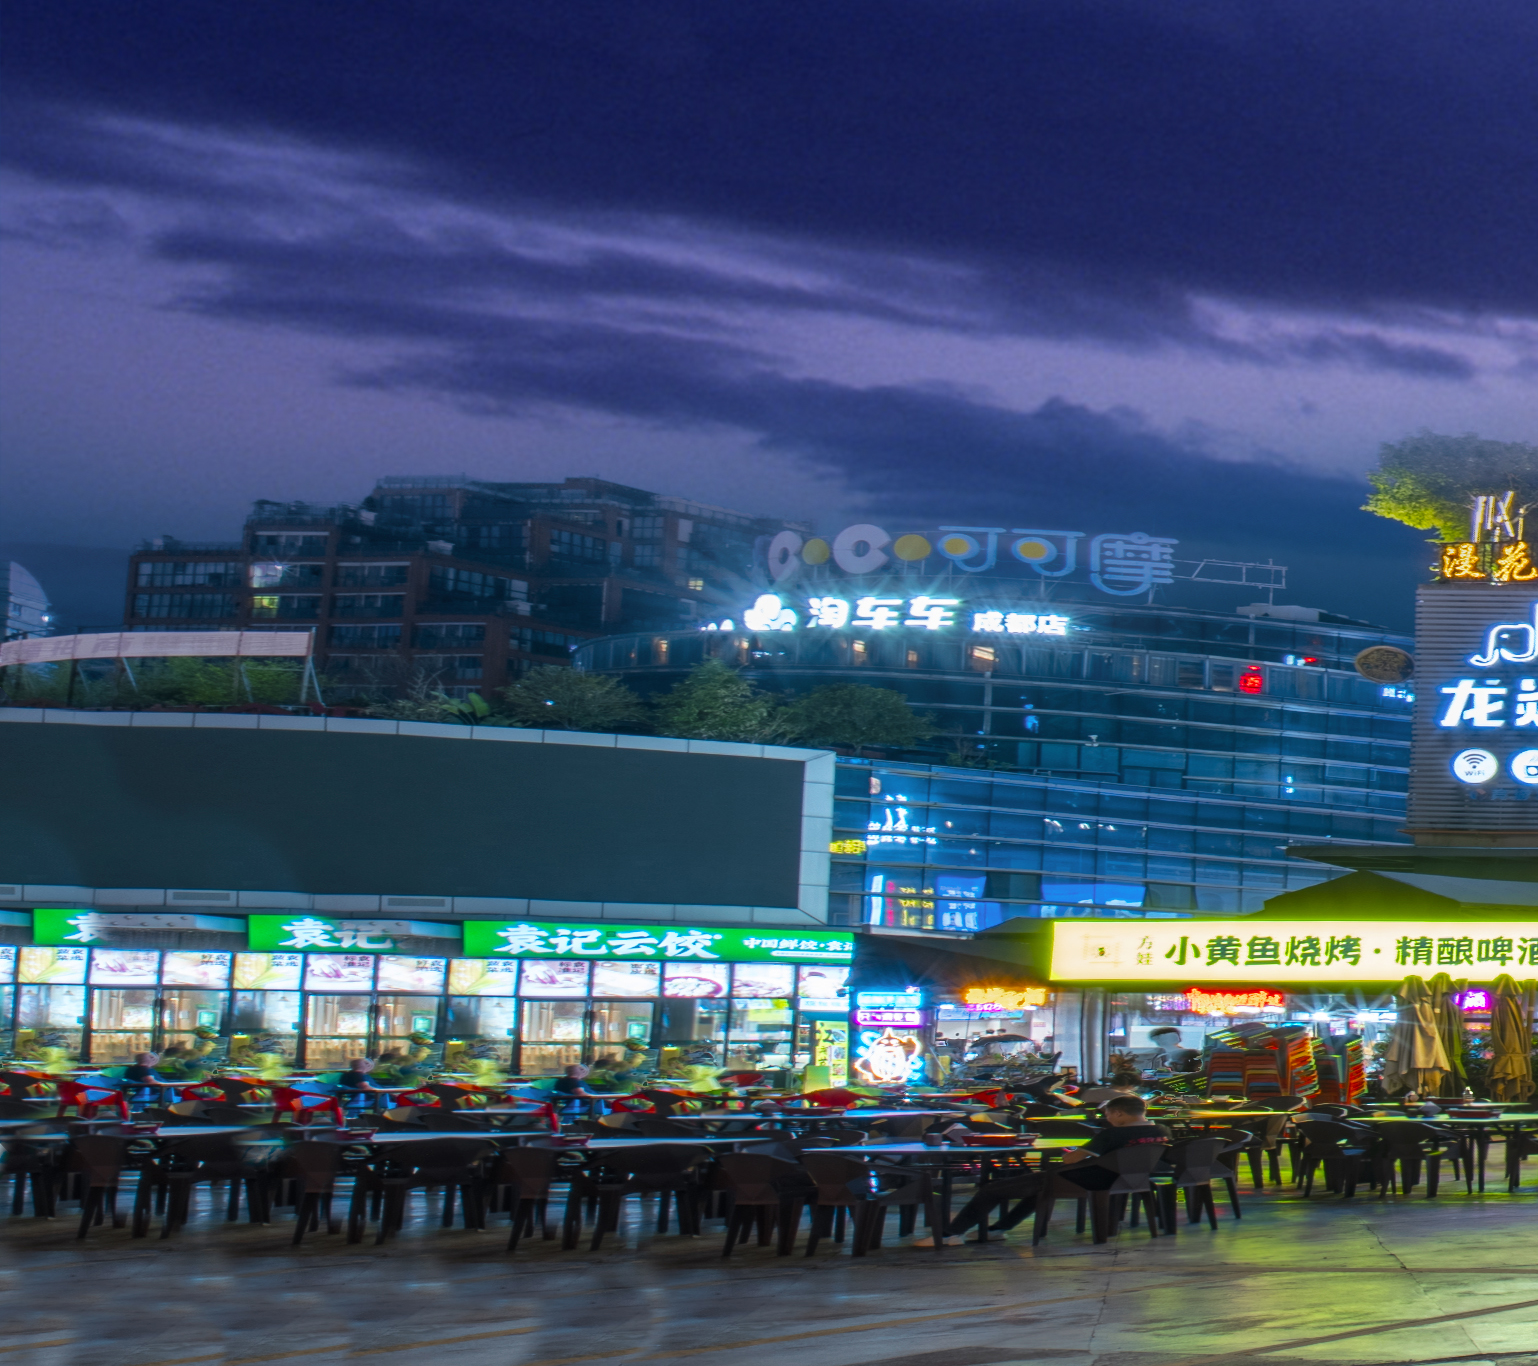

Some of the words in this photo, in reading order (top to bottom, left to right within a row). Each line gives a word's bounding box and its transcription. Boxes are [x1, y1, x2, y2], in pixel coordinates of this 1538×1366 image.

[1442, 541, 1538, 581] 漫花
[806, 595, 960, 630] 淘车车
[973, 610, 1070, 636] 成都店
[494, 923, 720, 958] 袁记云饺
